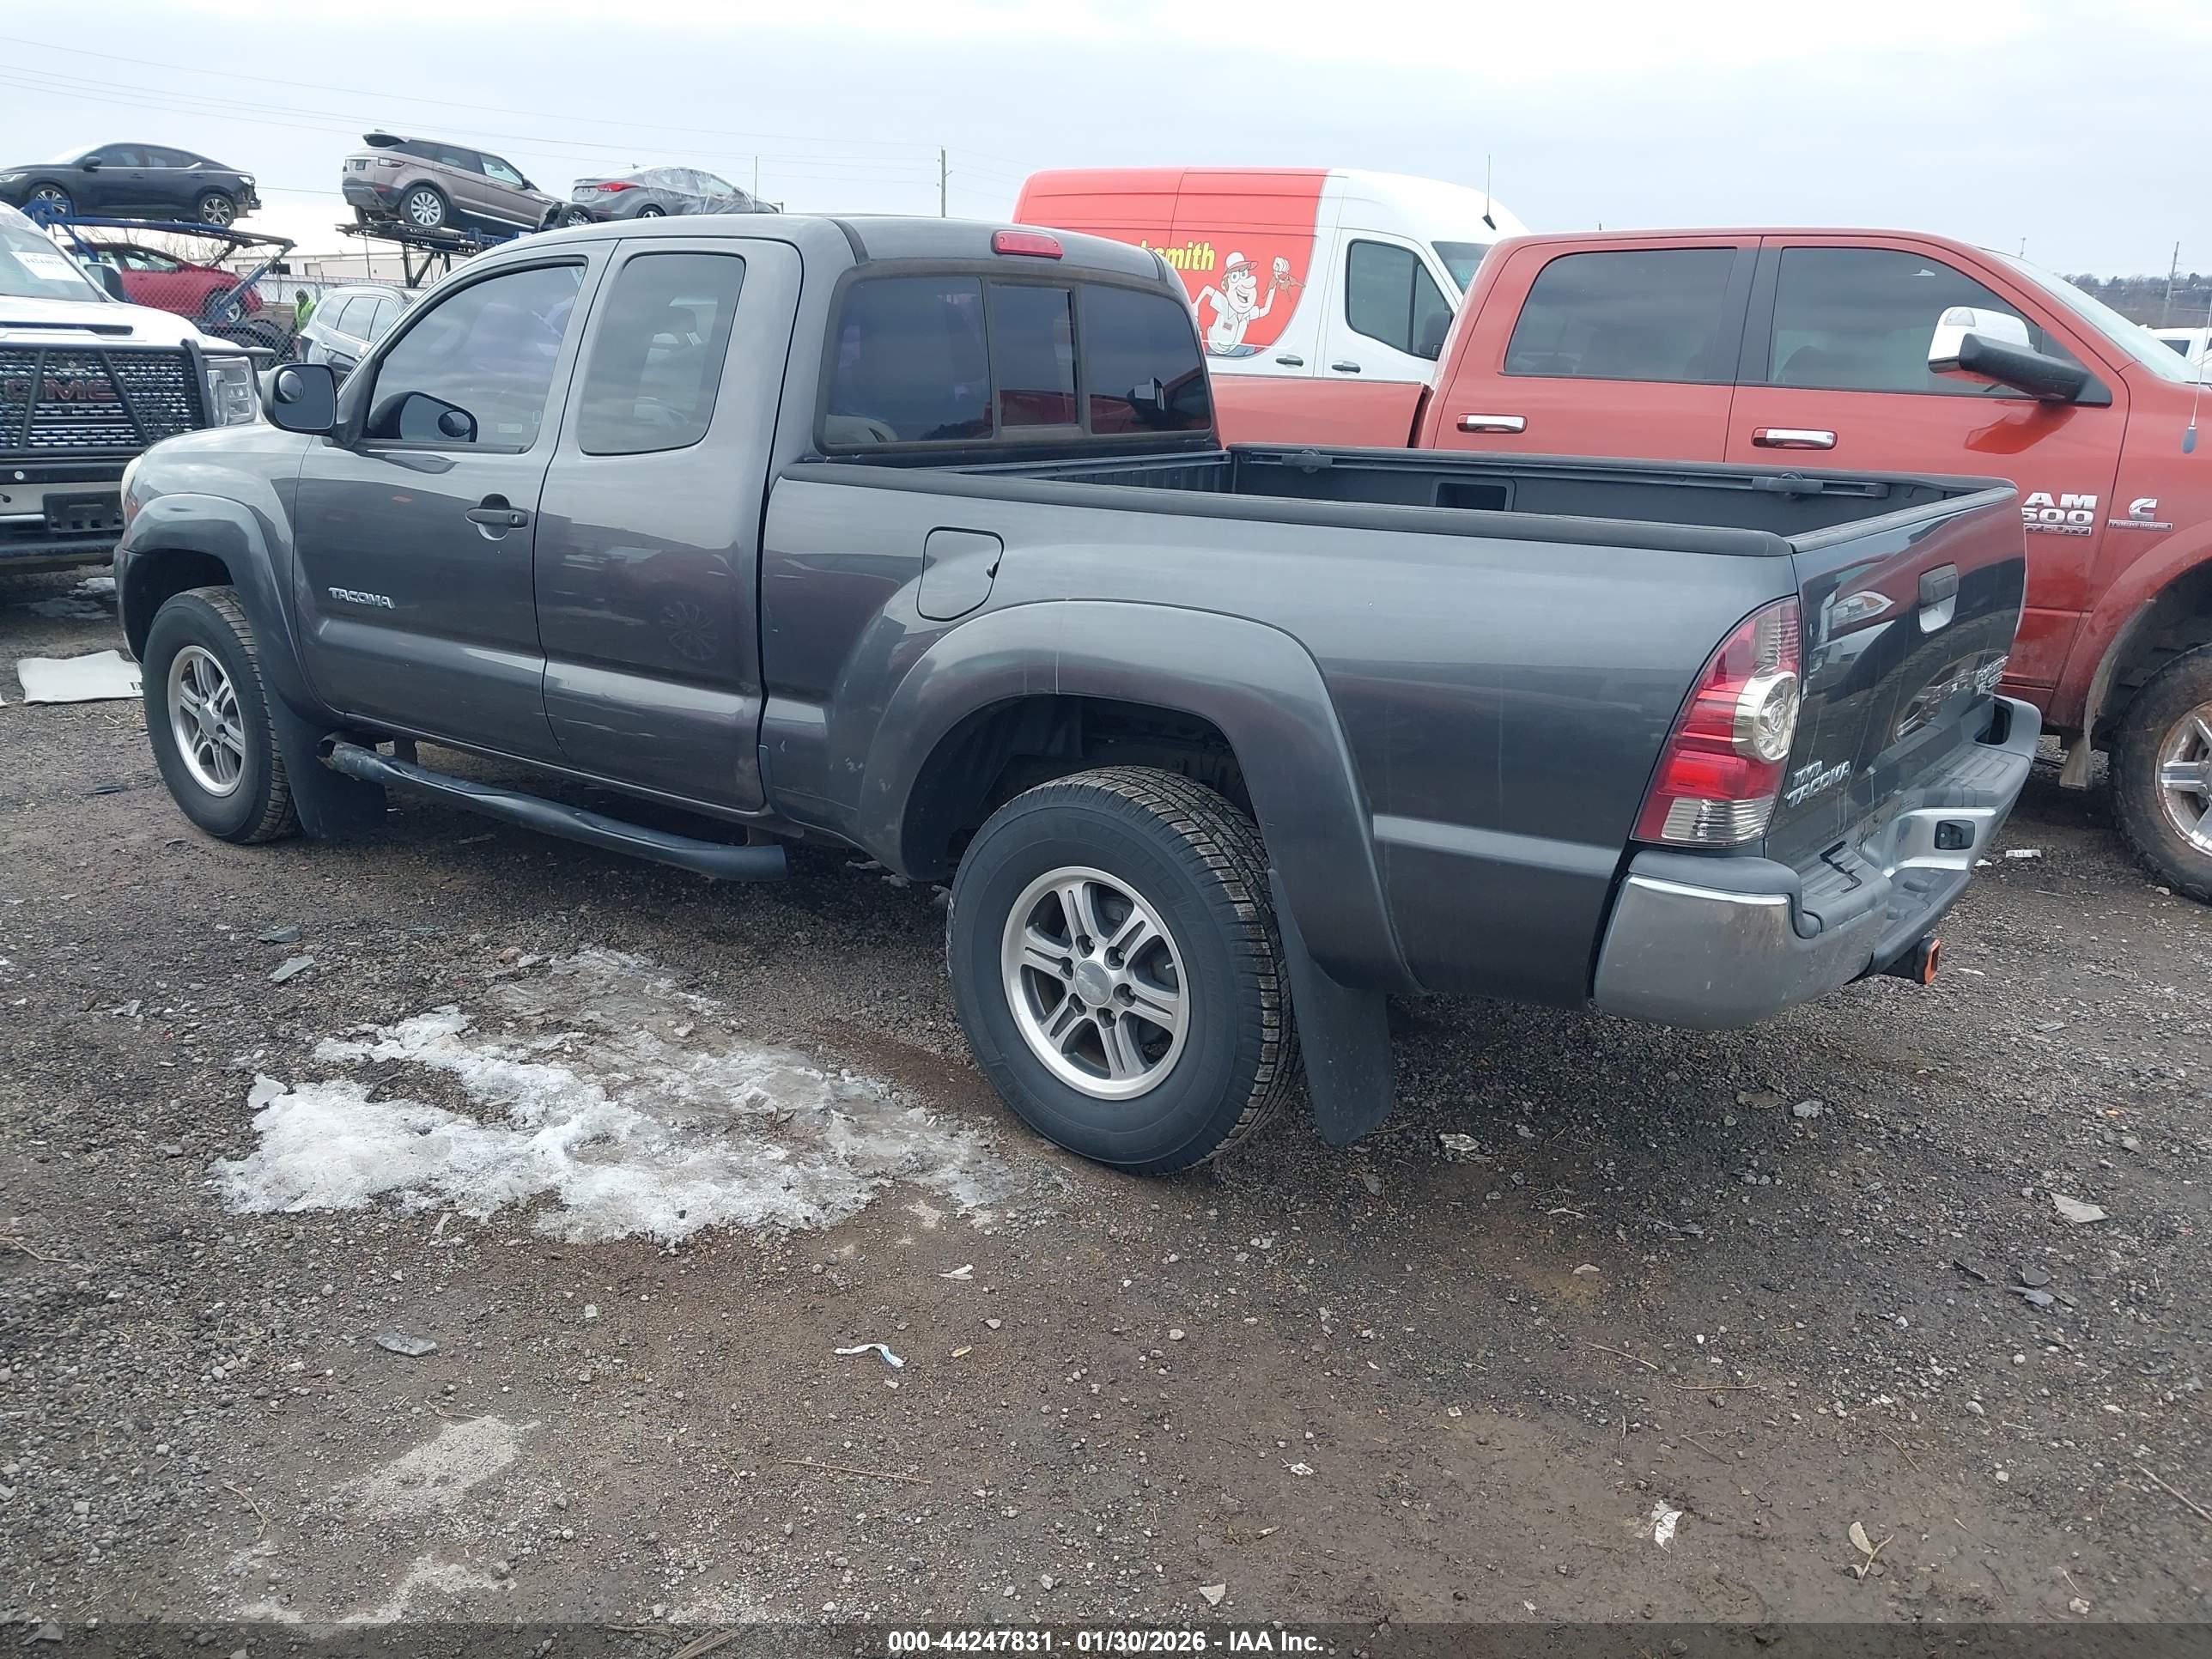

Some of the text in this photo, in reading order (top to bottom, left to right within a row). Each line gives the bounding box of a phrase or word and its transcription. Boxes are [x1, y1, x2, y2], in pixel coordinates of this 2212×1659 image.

[2022, 492, 2098, 509] AM
[2021, 507, 2094, 526] 500
[328, 586, 396, 609] TACOMA
[1784, 761, 1850, 808] TACOMA
